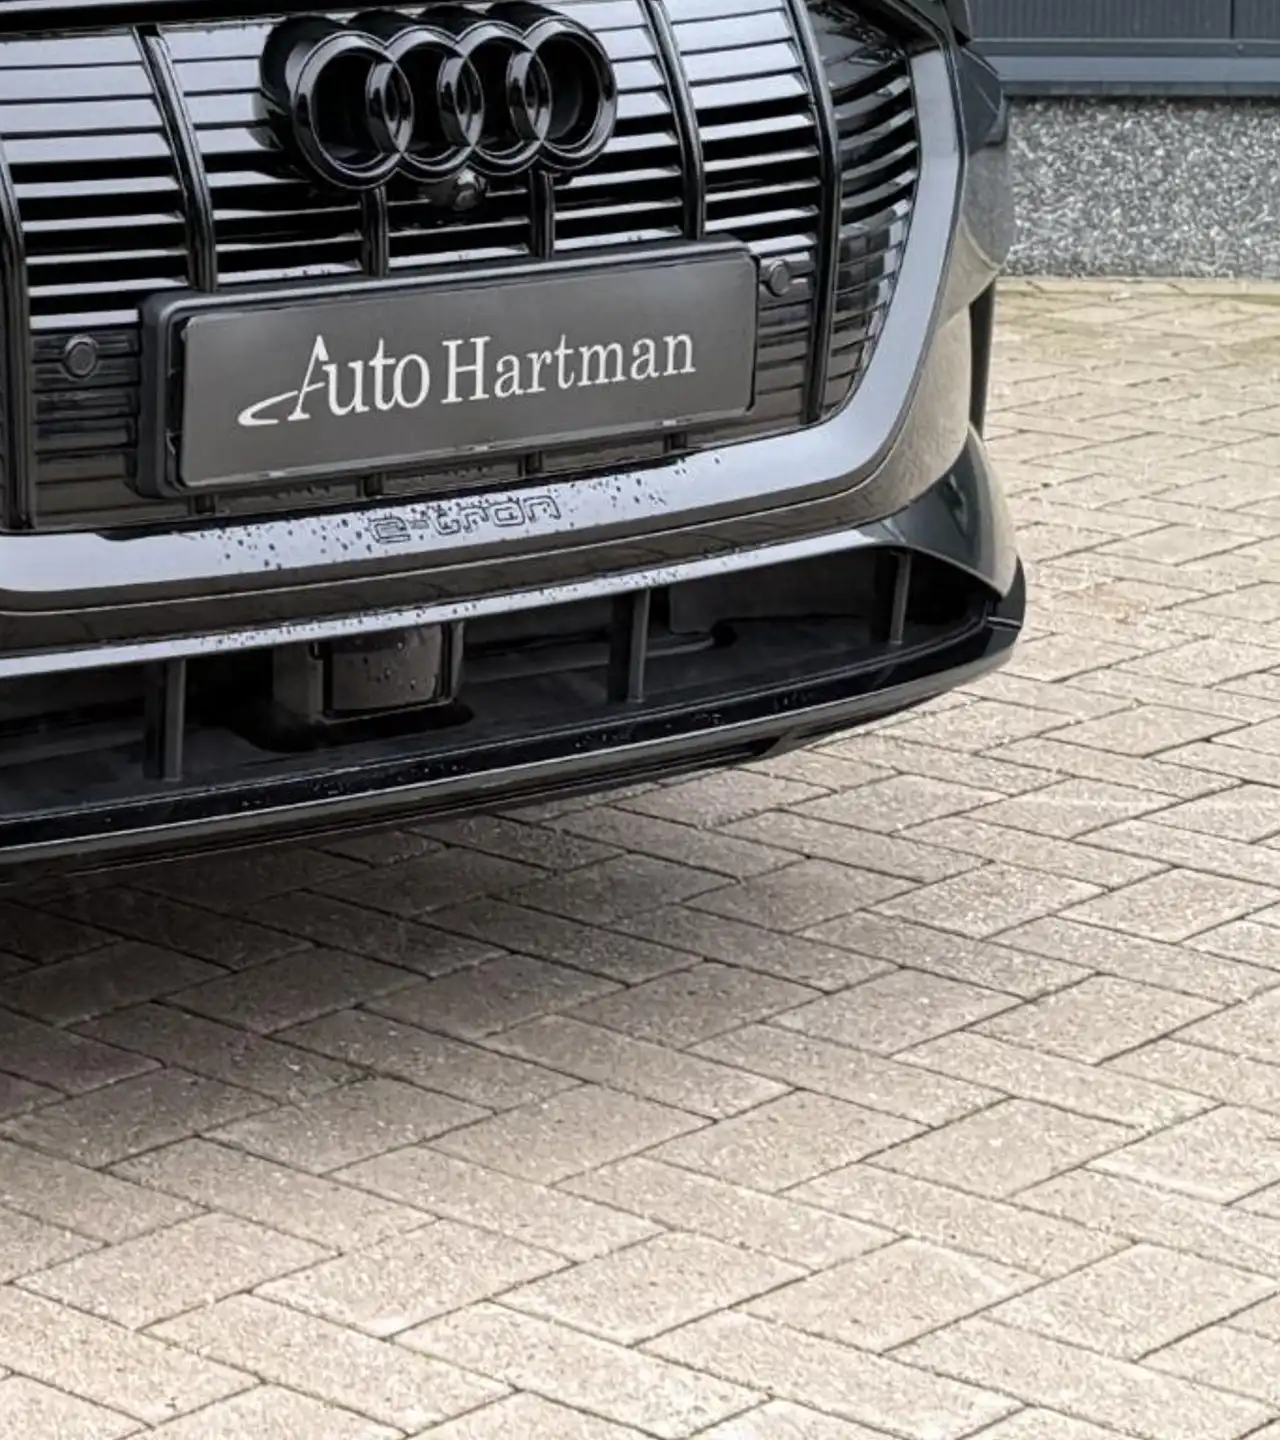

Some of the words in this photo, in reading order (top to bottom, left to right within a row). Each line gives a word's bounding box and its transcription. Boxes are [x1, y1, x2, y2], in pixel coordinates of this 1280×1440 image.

[238, 334, 430, 426] Auto
[441, 333, 697, 405] Hartman
[368, 494, 561, 545] e-tron
